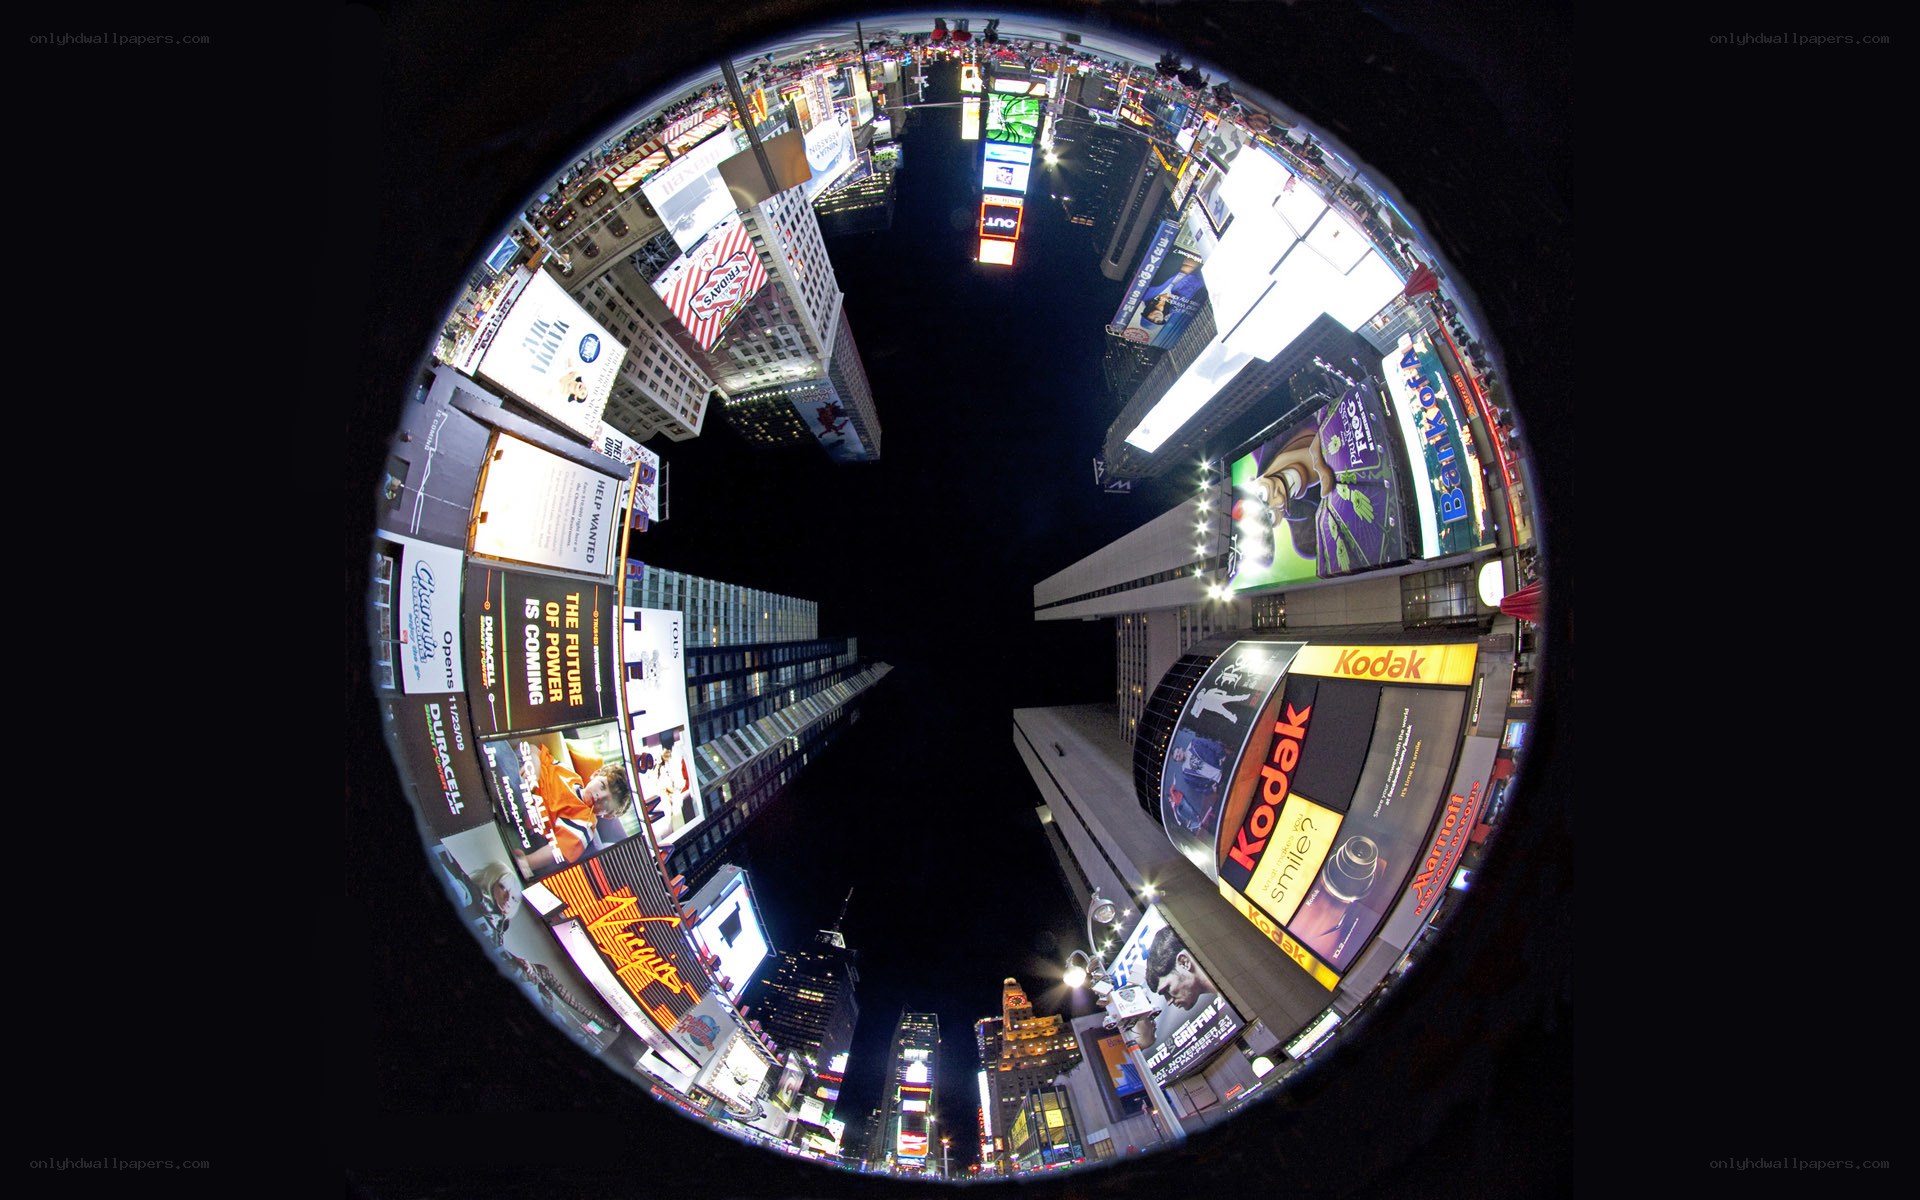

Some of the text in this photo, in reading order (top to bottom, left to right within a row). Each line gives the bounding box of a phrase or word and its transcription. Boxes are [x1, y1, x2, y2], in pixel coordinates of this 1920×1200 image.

[660, 148, 721, 195] maxell
[808, 130, 839, 154] ASSASSIN
[818, 139, 838, 156] NINJA
[1115, 287, 1141, 327] TIMES
[1135, 235, 1170, 288] SQUARE
[1405, 374, 1438, 410] of
[423, 408, 442, 451] IS COMING
[603, 436, 614, 457] OUR
[612, 439, 623, 462] THEI
[1336, 401, 1364, 467] PRINCESS
[1348, 399, 1368, 456] FROG
[1421, 408, 1468, 522] Bank
[585, 479, 605, 564] HELP WANTED
[414, 560, 438, 662] Charmin
[407, 612, 415, 643] enjoy
[412, 662, 420, 681] go.
[442, 630, 455, 689] Opens
[484, 616, 494, 688] DURACELL
[524, 598, 544, 707] IS COMING
[544, 601, 563, 703] OF POWER
[564, 592, 583, 707] THE FUTURE
[1334, 649, 1425, 677] Kodak
[447, 694, 465, 751] 11/23/09
[1412, 738, 1422, 761] smile.
[427, 702, 467, 815] DURACELL
[1380, 782, 1389, 799] your
[1386, 758, 1397, 783] answer
[1393, 740, 1402, 757] with
[1401, 707, 1409, 728] world
[1386, 723, 1413, 798] facebook.com/kodak
[1403, 769, 1414, 787] time
[1409, 760, 1416, 769] to
[443, 789, 457, 816] LAB
[516, 739, 564, 865] SICK ALL THE
[516, 778, 542, 836] TIME?
[1227, 703, 1310, 871] Kodak
[1292, 812, 1304, 833] you
[1410, 793, 1464, 899] Marriott
[1413, 779, 1480, 916] NEW YORK MARQUIS
[1270, 816, 1316, 902] smile?
[584, 894, 681, 994] Virgin
[1249, 904, 1306, 965] Kodak
[677, 1023, 715, 1052] HOLLYWOOD
[681, 1013, 712, 1034] PLANET
[1154, 1071, 1167, 1082] IVE
[1179, 1019, 1234, 1065] PAY-PER-VIEW
[1168, 1026, 1218, 1068] NOVEMBER
[1173, 995, 1226, 1048] GRIFFIN 2
[1147, 1046, 1170, 1069] RTIZ
